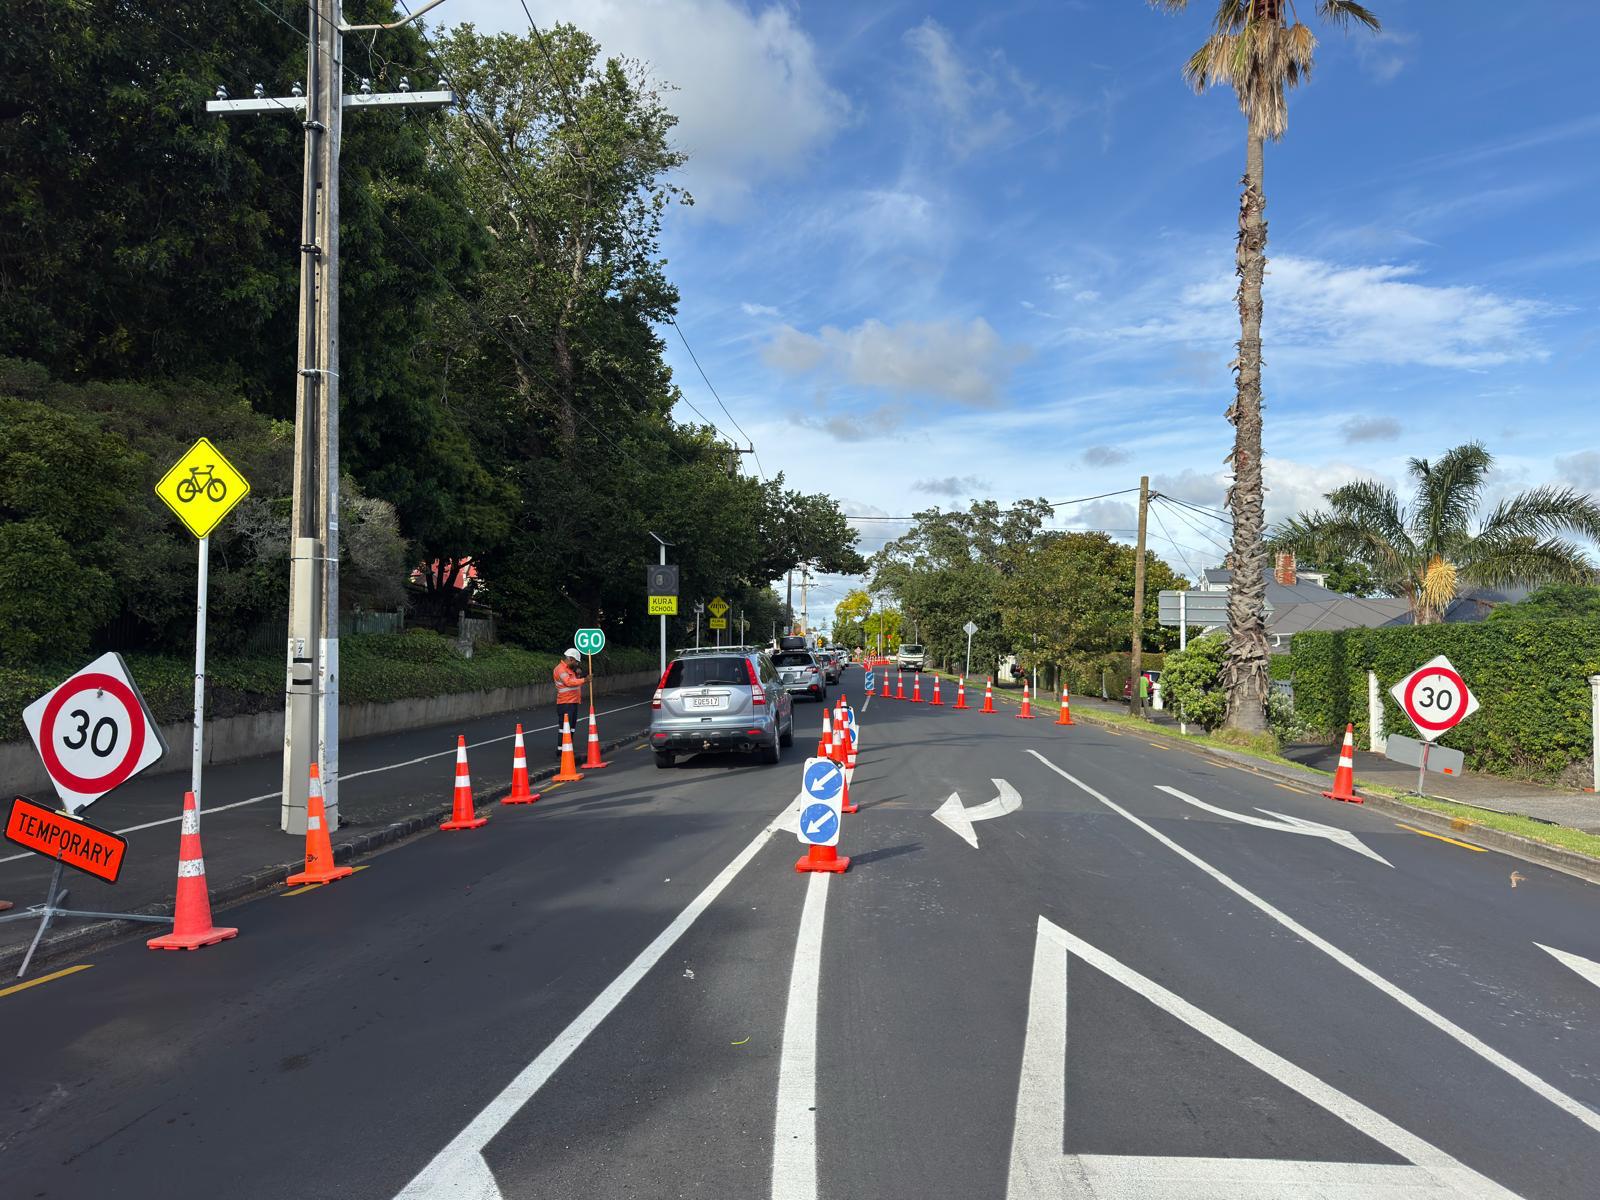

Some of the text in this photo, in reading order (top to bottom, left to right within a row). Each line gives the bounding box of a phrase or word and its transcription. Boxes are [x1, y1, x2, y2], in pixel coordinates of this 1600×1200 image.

[650, 605, 675, 613] SCHOOL
[577, 632, 602, 648] GO
[1418, 686, 1453, 711] 30
[63, 709, 118, 758] 30
[18, 812, 115, 868] TEMPORARY
